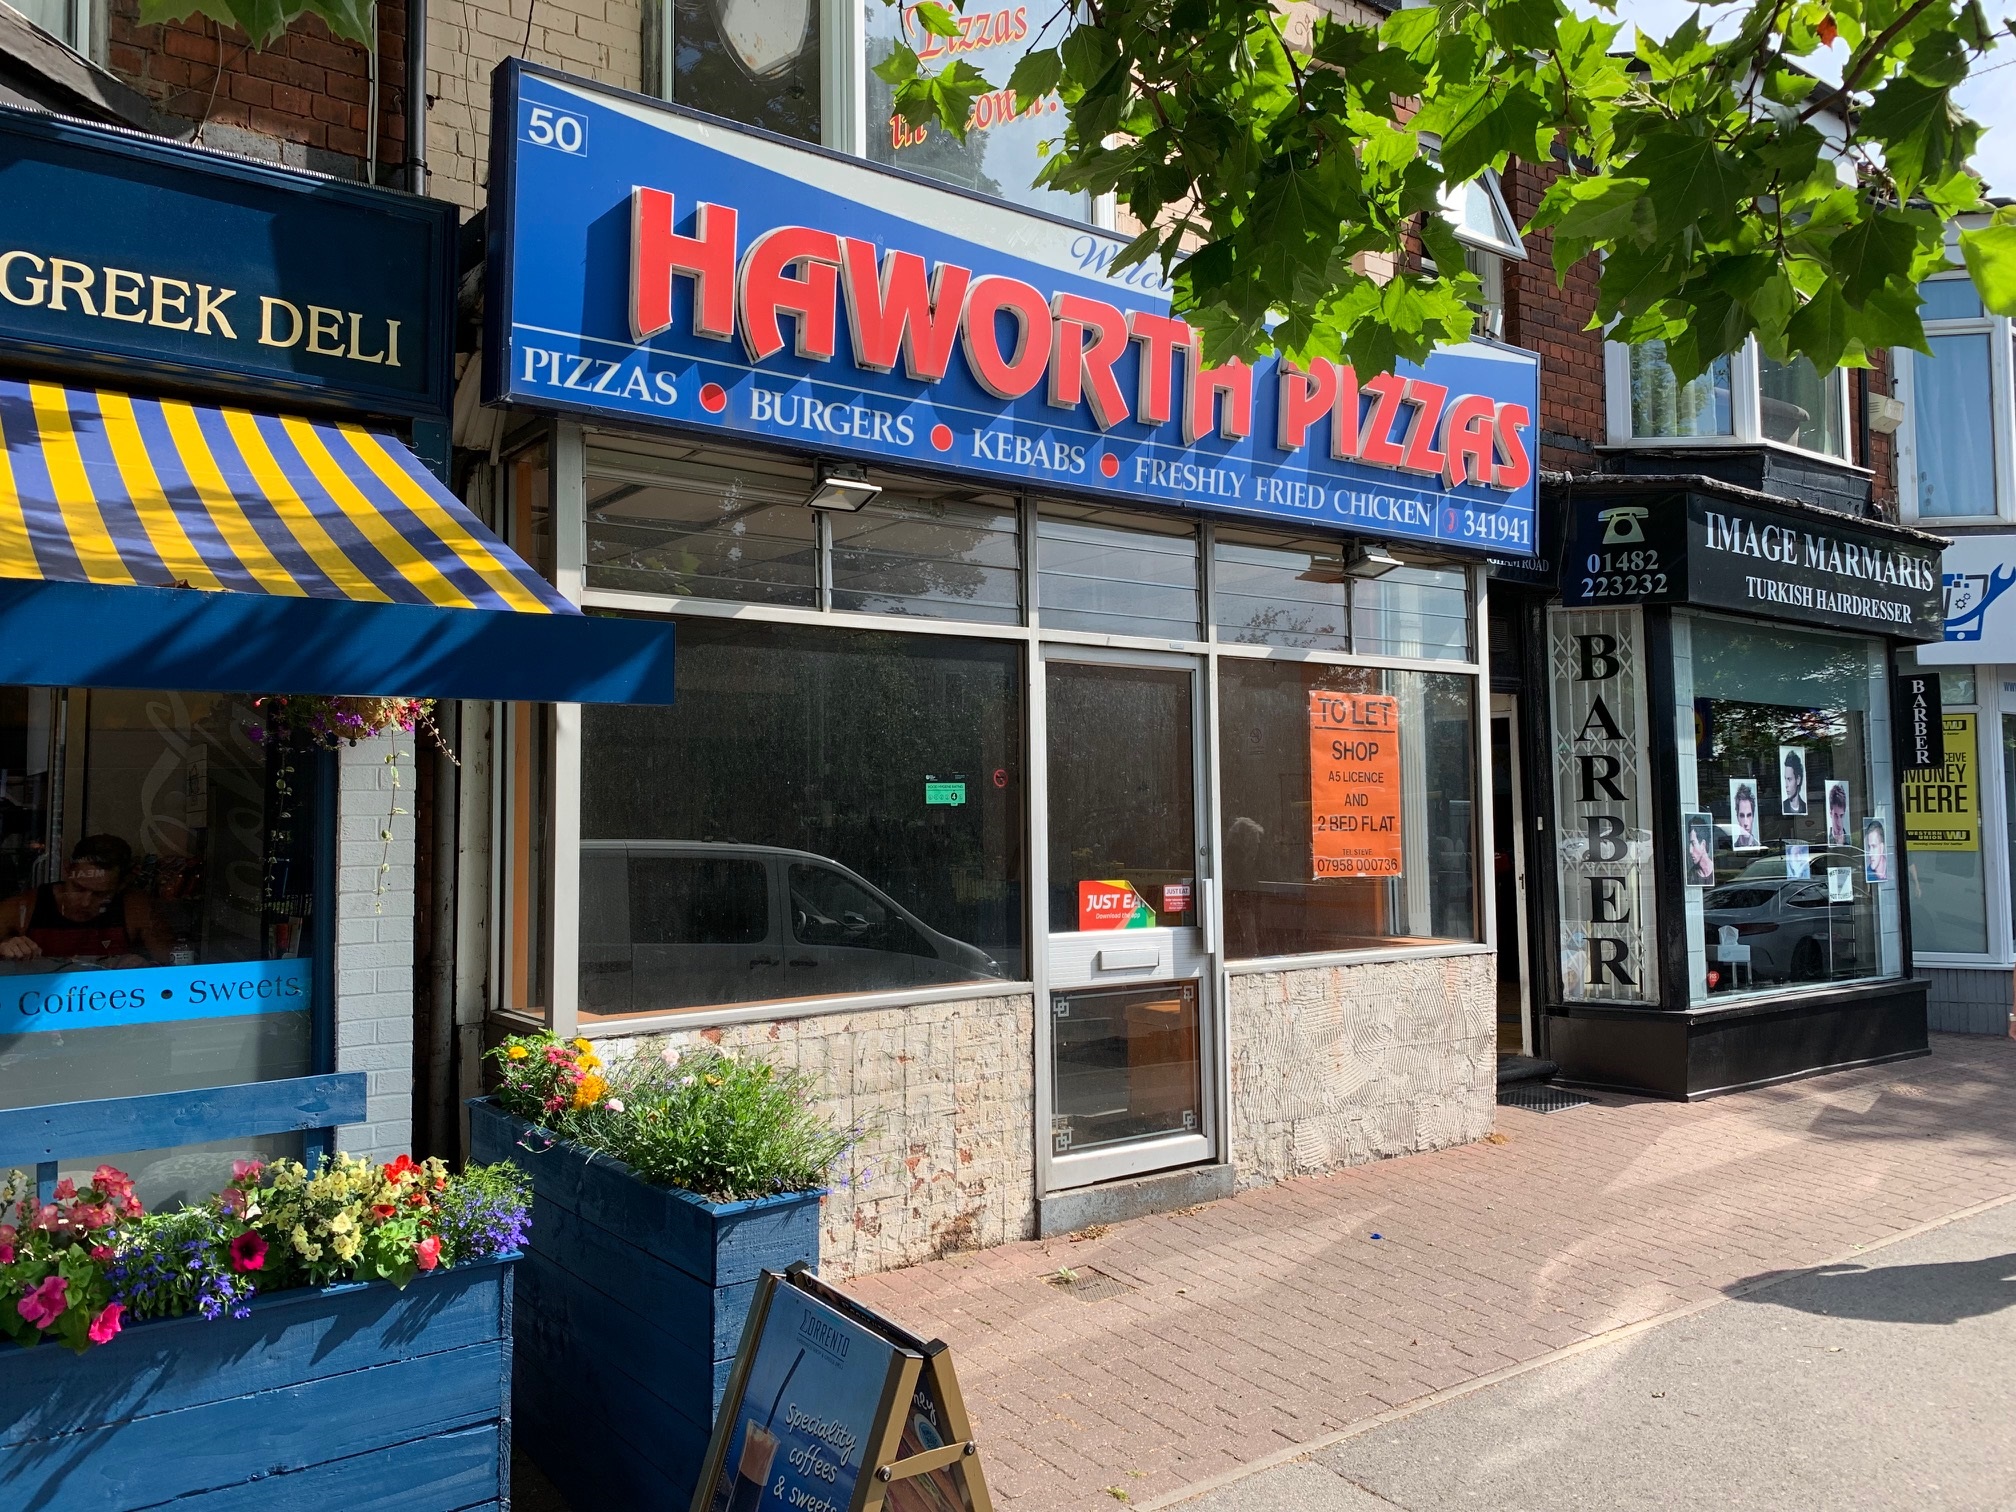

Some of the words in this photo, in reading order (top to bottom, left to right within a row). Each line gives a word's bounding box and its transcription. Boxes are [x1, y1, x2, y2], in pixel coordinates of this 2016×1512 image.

[528, 107, 582, 154] 50
[0, 250, 237, 341] GREEK
[259, 296, 402, 368] DELI
[629, 185, 1253, 447] HAWORTH
[1279, 356, 1531, 492] PIZZAS
[521, 346, 678, 406] PIZZAS
[750, 387, 915, 447] BURGERS
[972, 427, 1086, 476] KEBABS
[1134, 456, 1246, 499] FRESHLY
[1257, 477, 1326, 512] FRIED
[1333, 490, 1432, 528] CHICKEN
[1463, 508, 1532, 545] 341941
[1522, 558, 1549, 572] ROAD
[1587, 549, 1659, 574] 01482
[1704, 511, 1798, 565] IMAGE
[1803, 532, 1934, 592] MARMARIS
[1581, 573, 1668, 598] 223232
[1745, 575, 1813, 608] TURKISH
[1816, 589, 1912, 624] HAIRDRESSER
[1318, 698, 1346, 723] TO
[1352, 701, 1392, 727] LET
[1911, 679, 1931, 764] BARBER
[1332, 740, 1379, 762] SHOP
[1328, 770, 1341, 782] A5
[1343, 771, 1384, 784] LICENCE
[1904, 764, 1967, 783] MONEY
[1344, 793, 1369, 807] AND
[1573, 633, 1638, 986] BARBER
[1905, 785, 1968, 813] HERE
[1318, 815, 1326, 832] 2
[1329, 815, 1358, 832] BED
[1361, 815, 1395, 832] FLAT
[1317, 858, 1354, 872] 07958
[1356, 857, 1398, 872] 000736
[1342, 848, 1353, 856] TEL
[1354, 848, 1372, 856] STEVE
[1086, 893, 1120, 912] JUST
[1095, 912, 1121, 920] Download
[1131, 912, 1141, 920] app
[18, 984, 146, 1017] Coffees
[188, 974, 300, 1004] Sweets
[785, 1402, 857, 1467] Speciality
[789, 1444, 838, 1483] coffees
[773, 1475, 786, 1500] &
